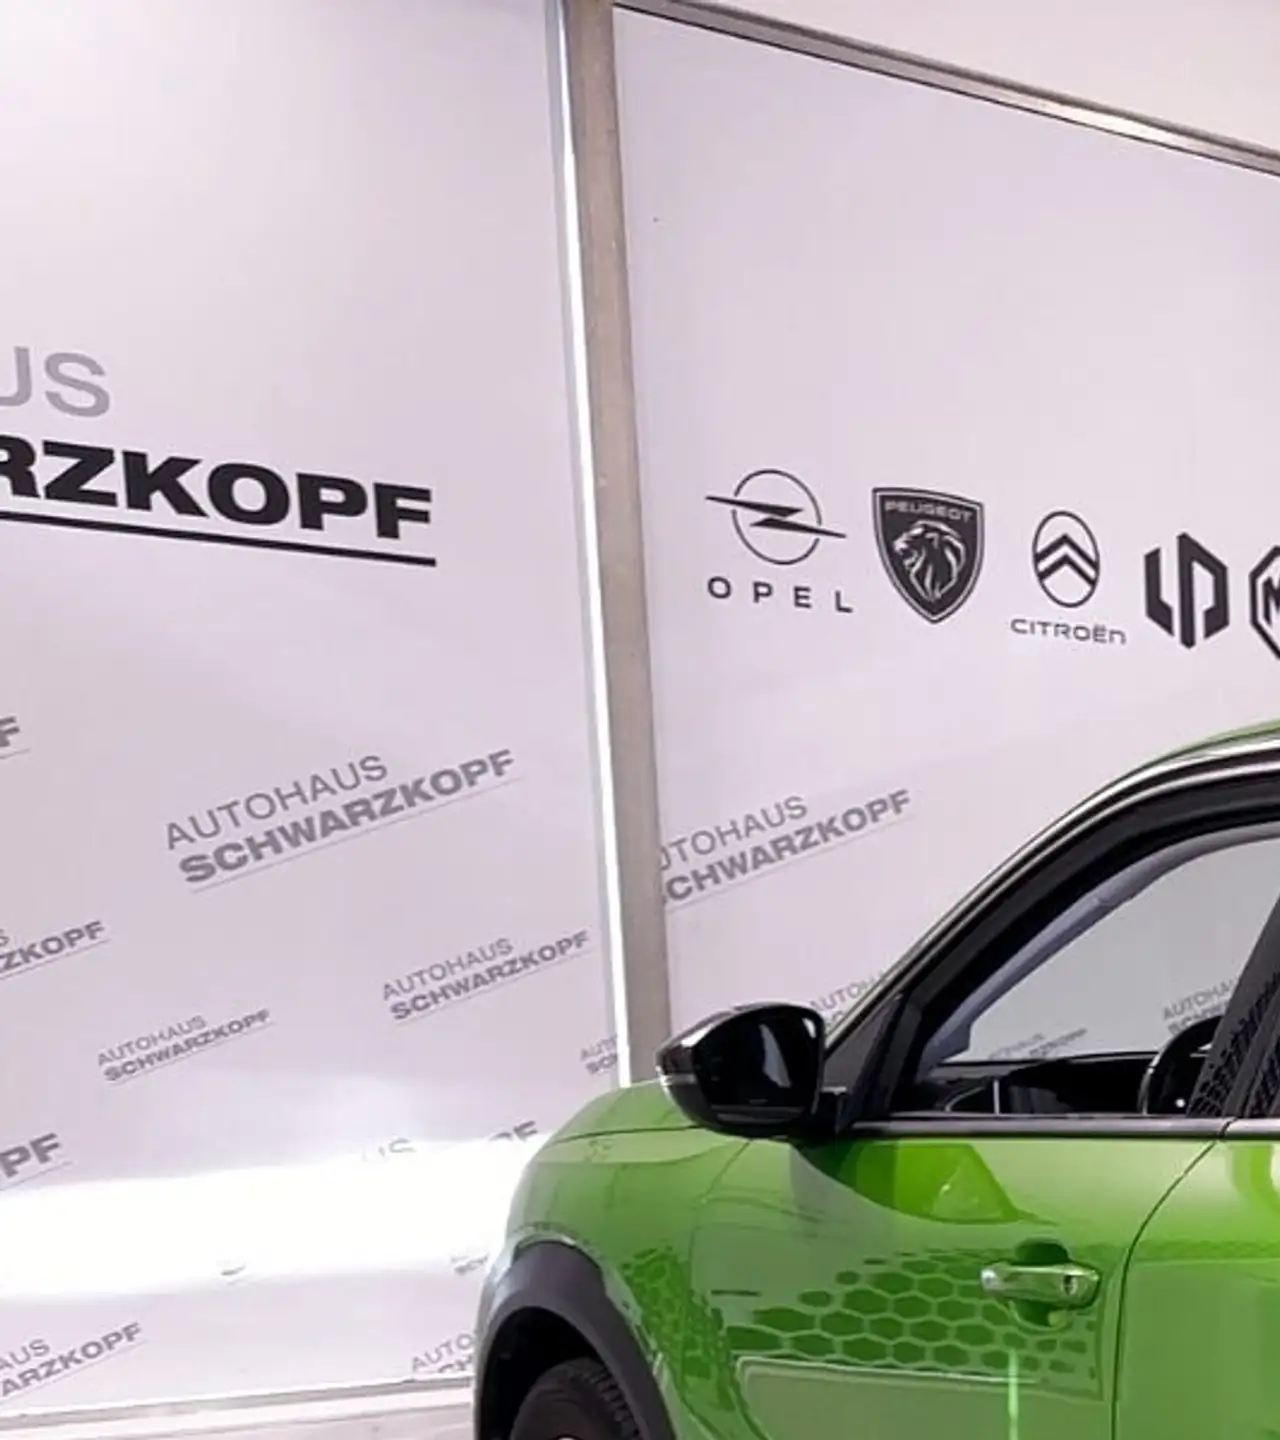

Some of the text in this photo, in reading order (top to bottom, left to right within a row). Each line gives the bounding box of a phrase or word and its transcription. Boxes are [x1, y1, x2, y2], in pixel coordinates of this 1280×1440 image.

[884, 500, 974, 523] PEUGEOT
[707, 577, 853, 614] OPEL
[166, 755, 388, 850] AUTOHAUS
[179, 749, 515, 885] SCHWARZKOPF
[382, 937, 513, 1000] AUTOHAUS
[390, 930, 591, 1020] SCHWARZKOPF
[97, 1015, 206, 1067] AUTOHAUS
[103, 1009, 271, 1083] SCHWARZKOPF
